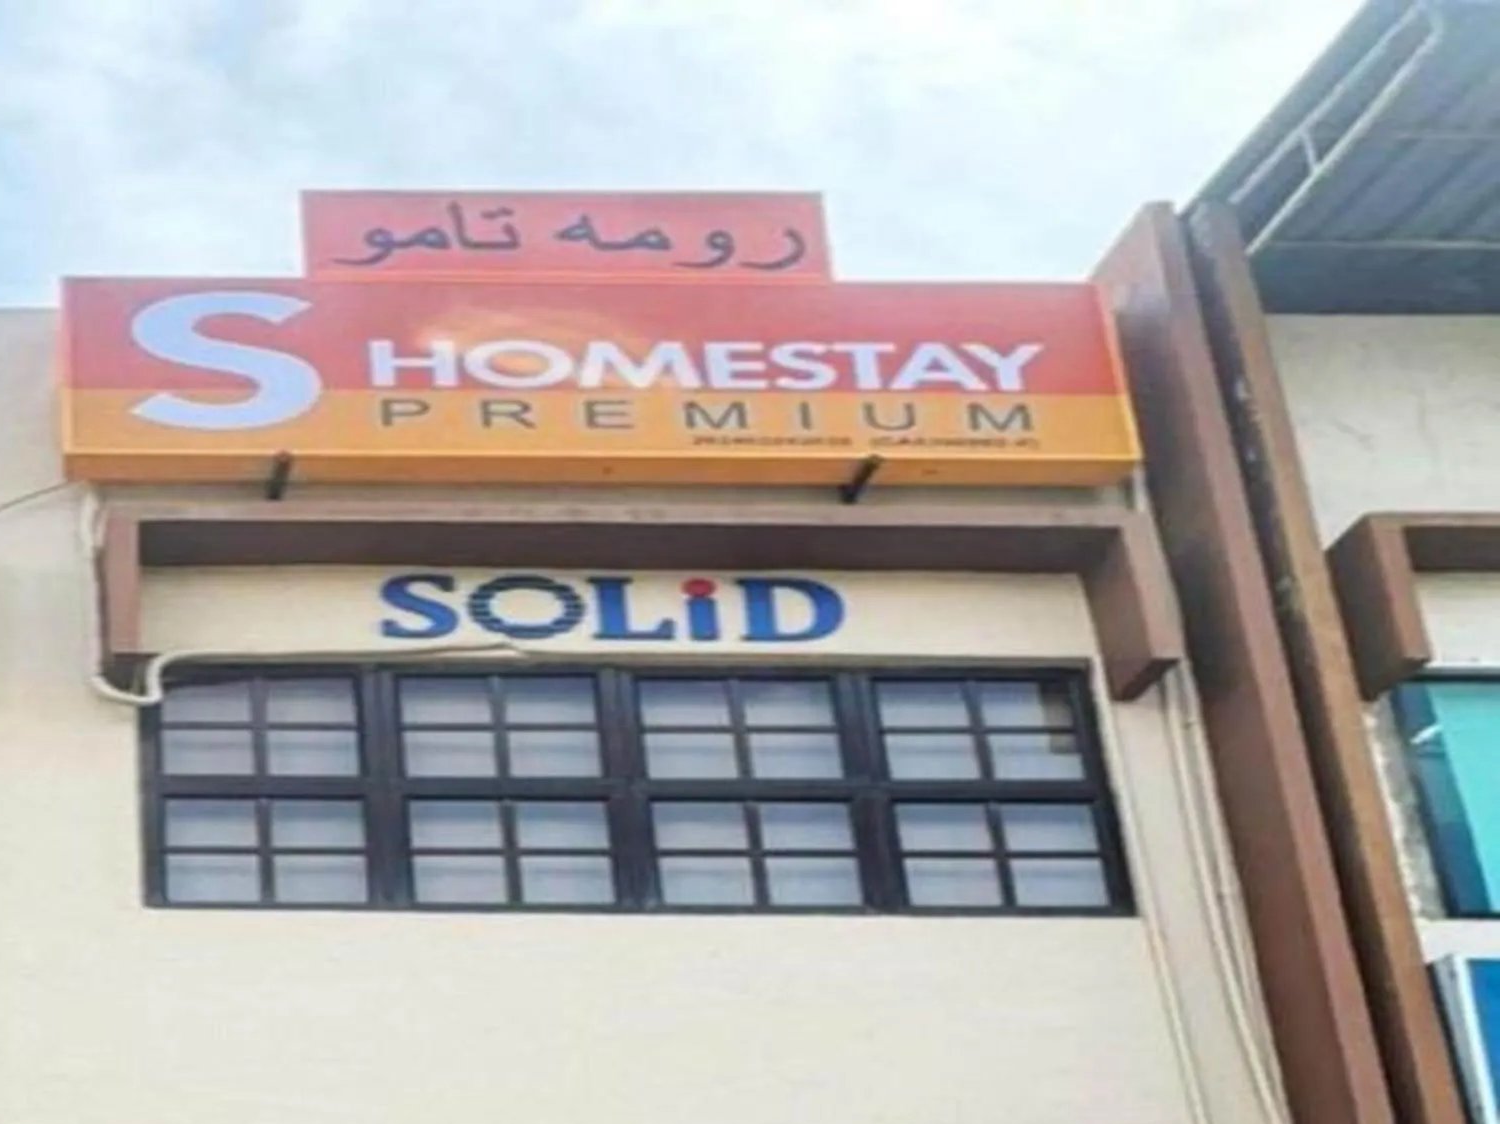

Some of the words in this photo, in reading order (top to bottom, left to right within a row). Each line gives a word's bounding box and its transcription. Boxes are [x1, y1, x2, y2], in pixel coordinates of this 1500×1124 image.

[130, 291, 323, 431] S
[368, 339, 1045, 392] HOMESTAY
[379, 399, 1035, 432] PREMIUM
